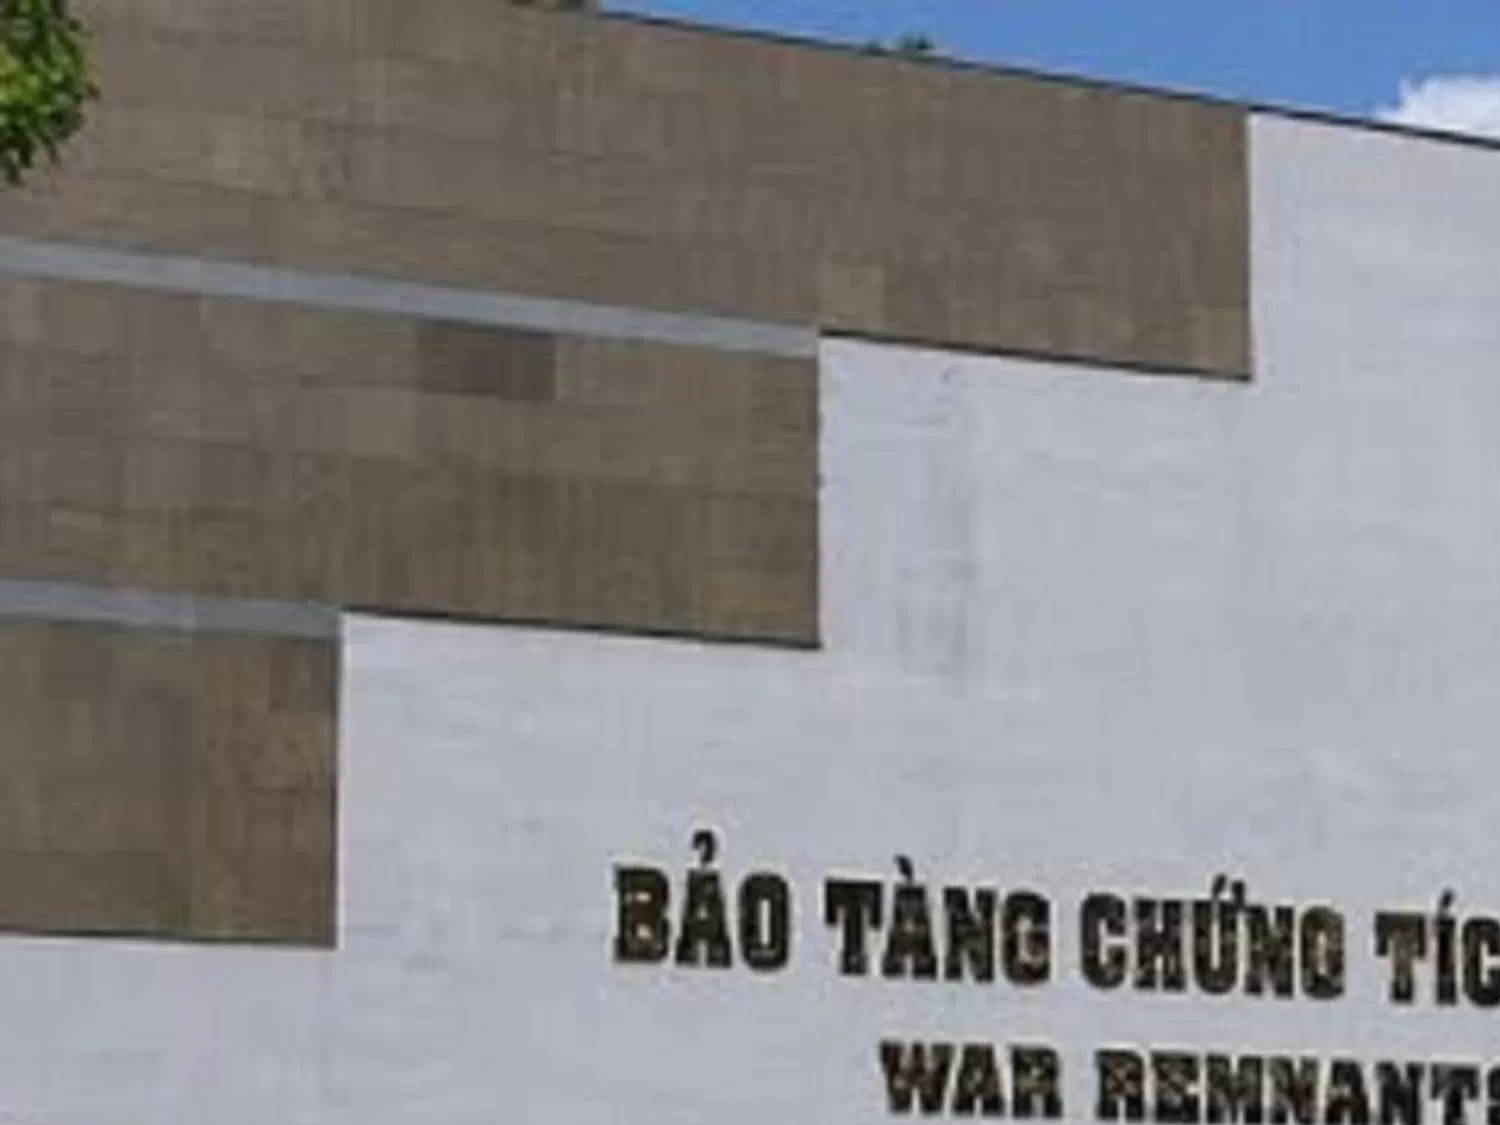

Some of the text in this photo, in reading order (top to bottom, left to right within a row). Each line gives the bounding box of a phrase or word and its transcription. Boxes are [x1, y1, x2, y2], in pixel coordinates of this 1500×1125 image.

[612, 829, 792, 973] BẢO
[824, 855, 1051, 987] TÀNG
[1079, 873, 1345, 1001] CHỨNG
[878, 1039, 1064, 1121] WAR
